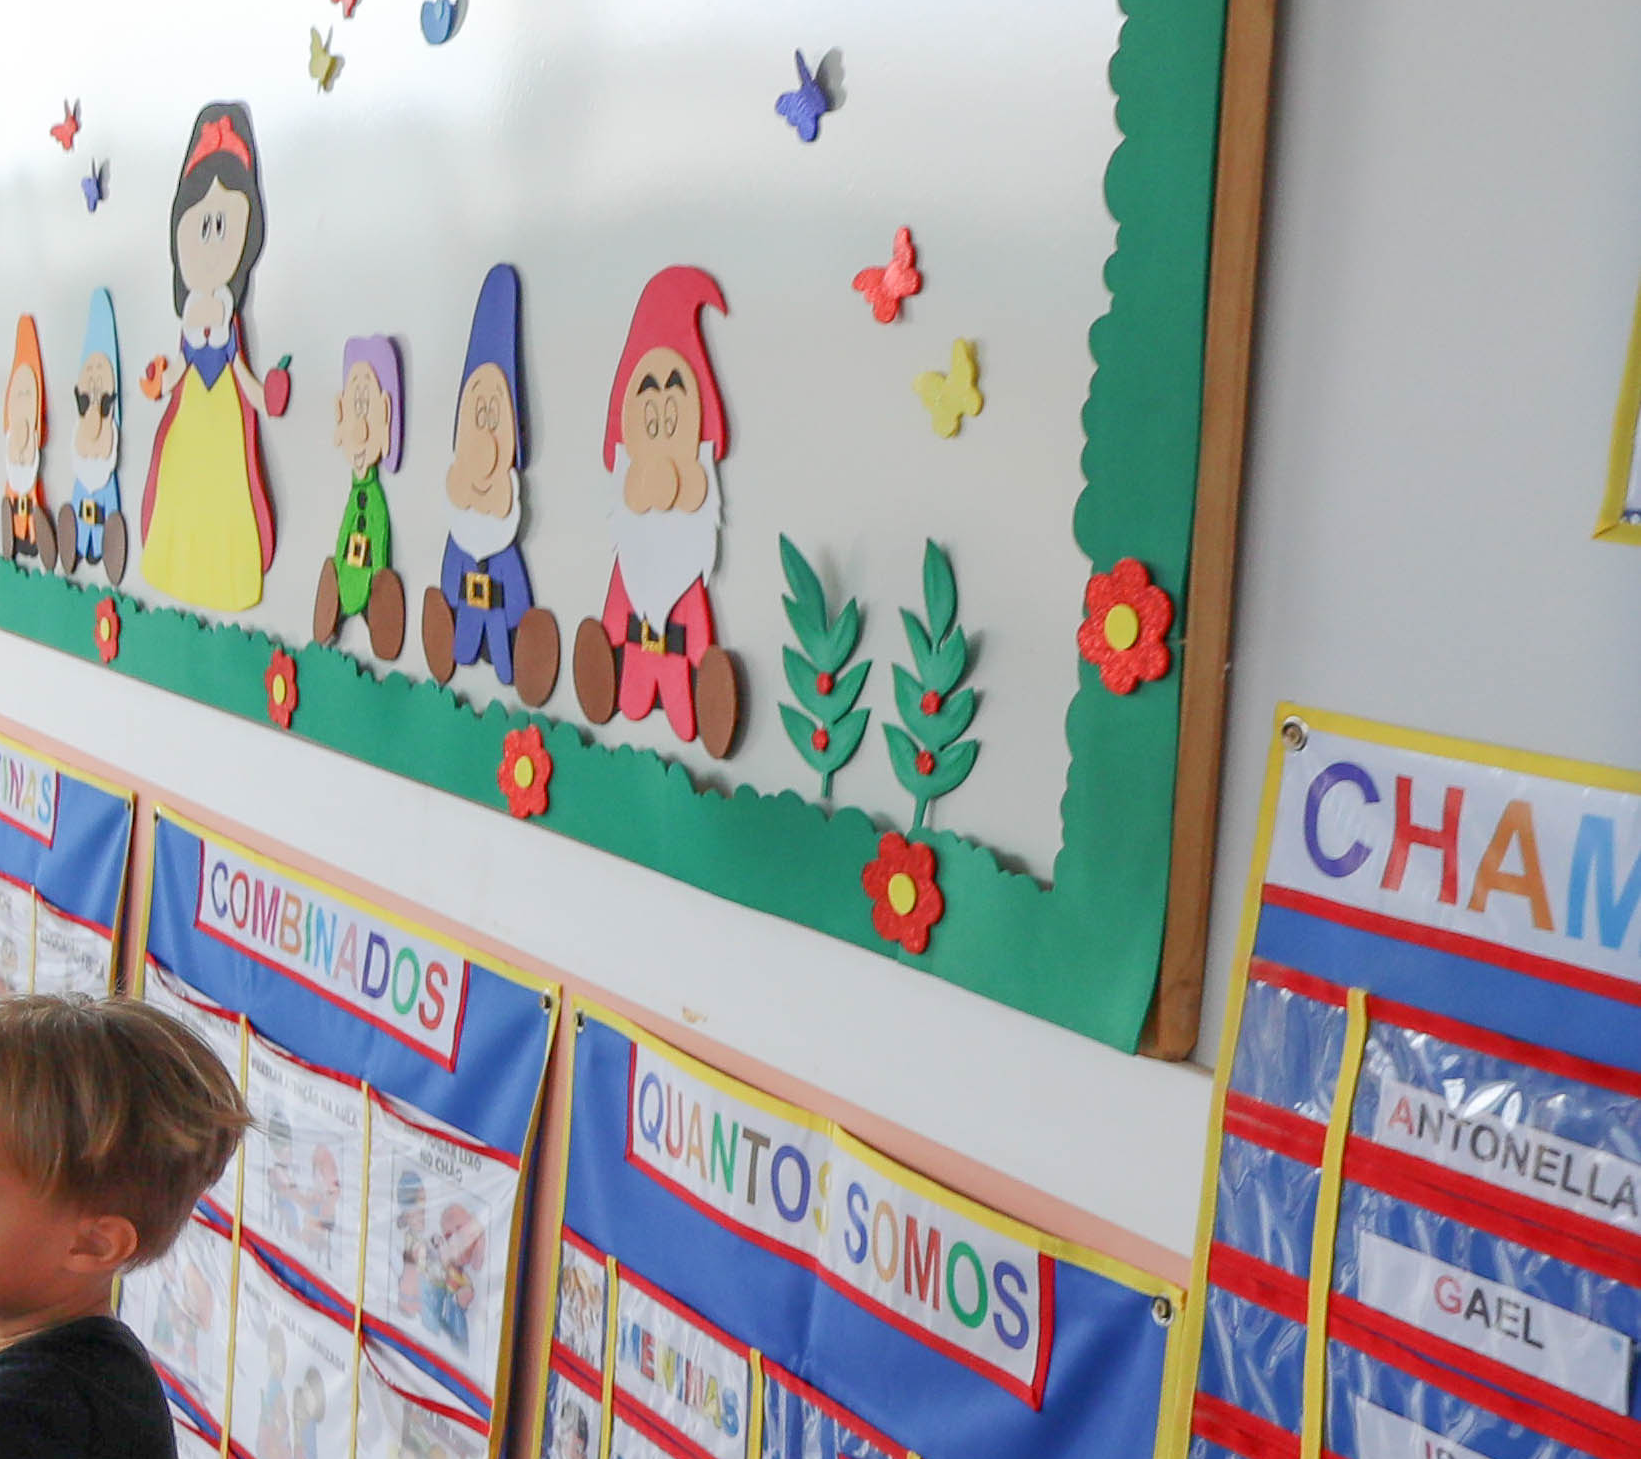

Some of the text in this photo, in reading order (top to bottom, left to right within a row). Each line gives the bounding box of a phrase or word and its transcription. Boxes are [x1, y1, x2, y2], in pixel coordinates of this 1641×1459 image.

[211, 861, 448, 1030] COMBINADOS
[638, 1071, 1030, 1350] QUANTOS SOMOS
[1388, 1095, 1641, 1217] ANTONELLA
[1433, 1275, 1545, 1350] GAEL
[618, 1314, 740, 1438] MENINAS
